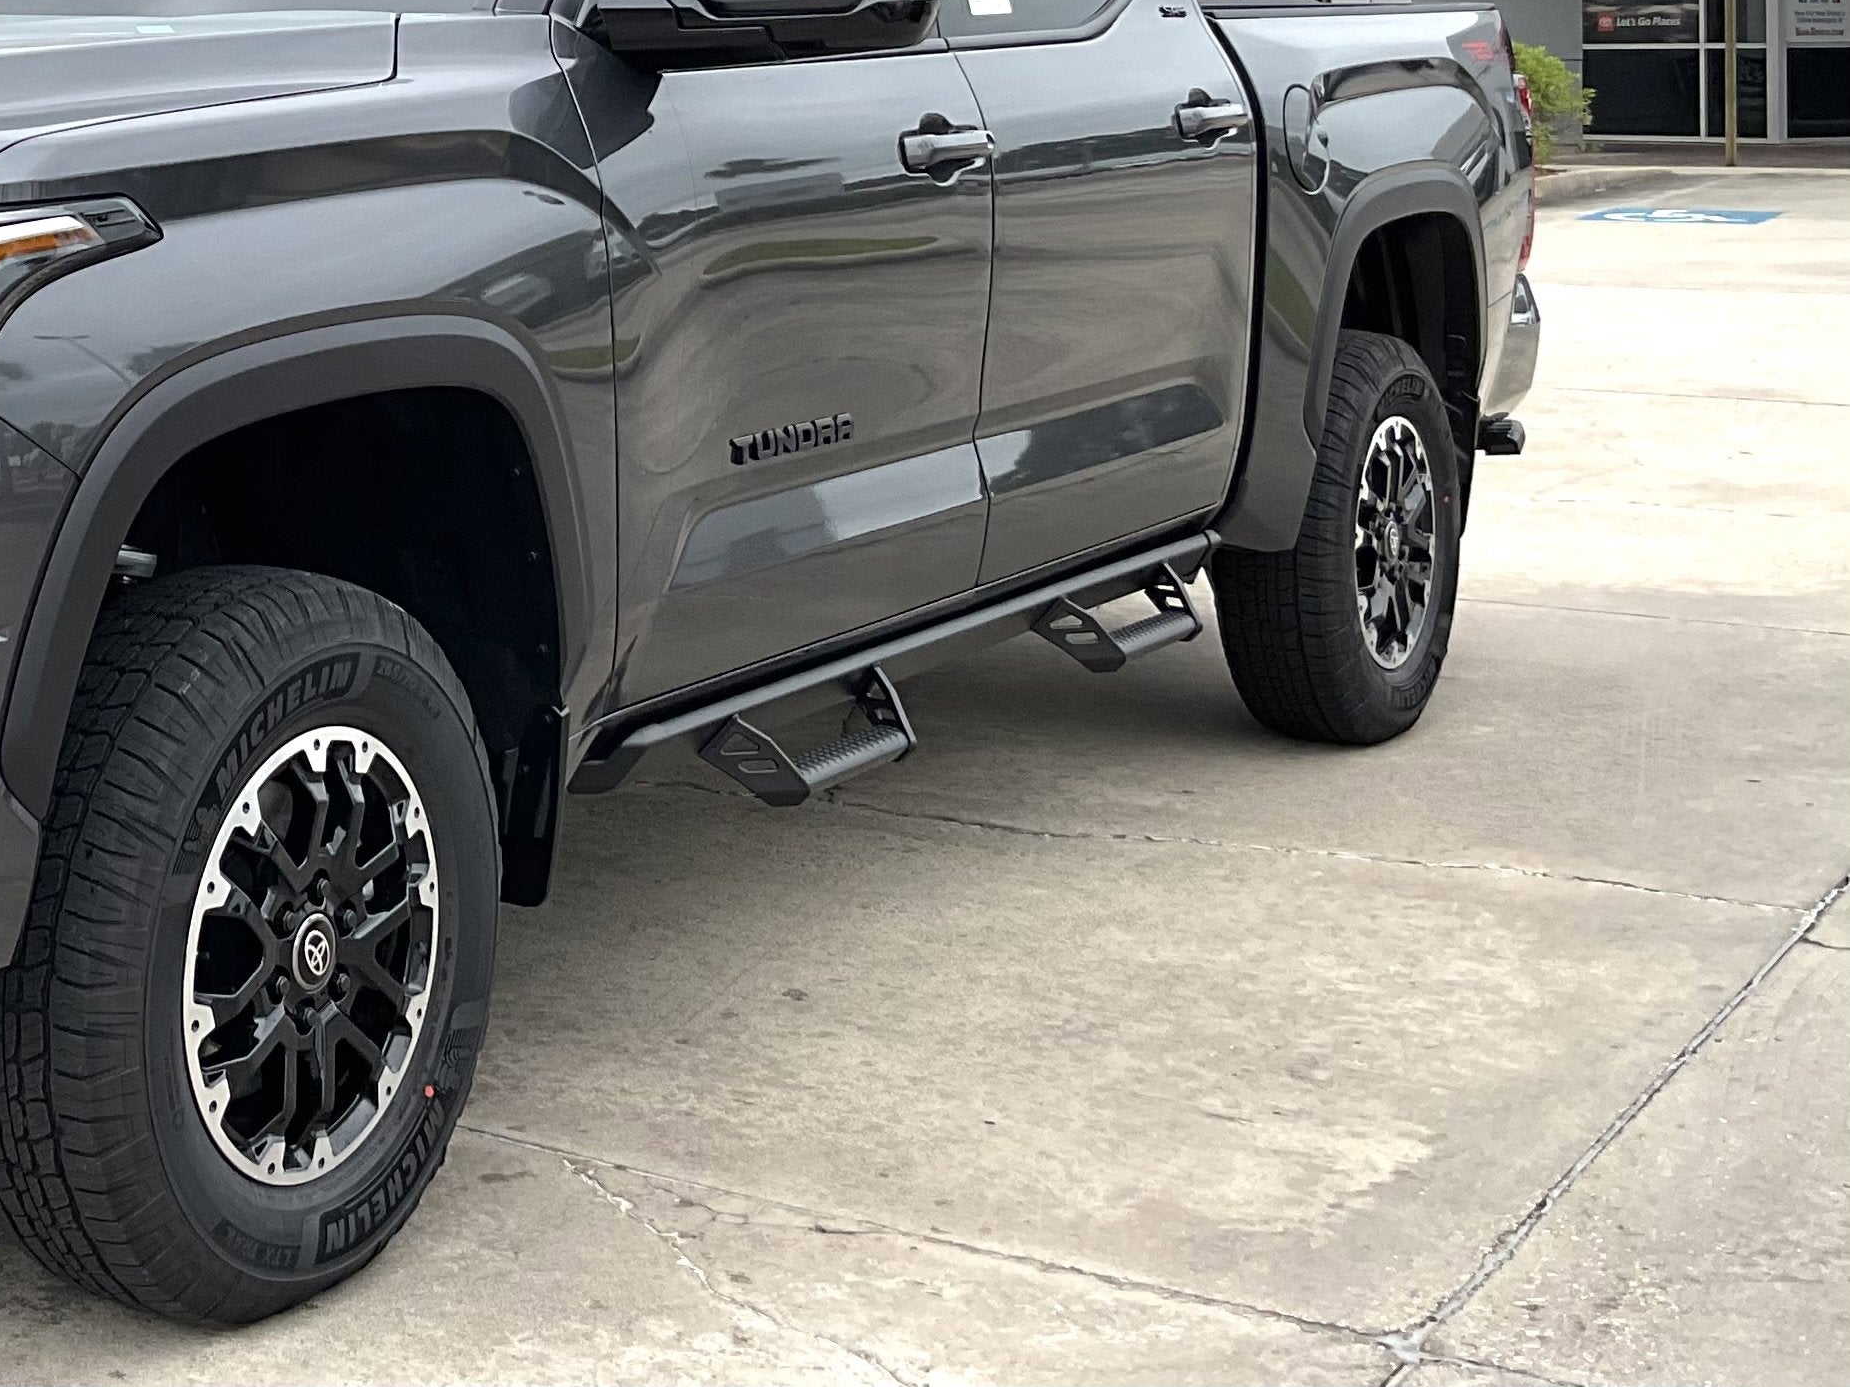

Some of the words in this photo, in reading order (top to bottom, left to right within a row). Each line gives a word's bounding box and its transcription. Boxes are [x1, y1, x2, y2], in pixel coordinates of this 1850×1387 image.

[729, 412, 855, 465] TUNDRA
[215, 661, 352, 800] MICHELIN
[325, 1096, 446, 1258] MICHELIN
